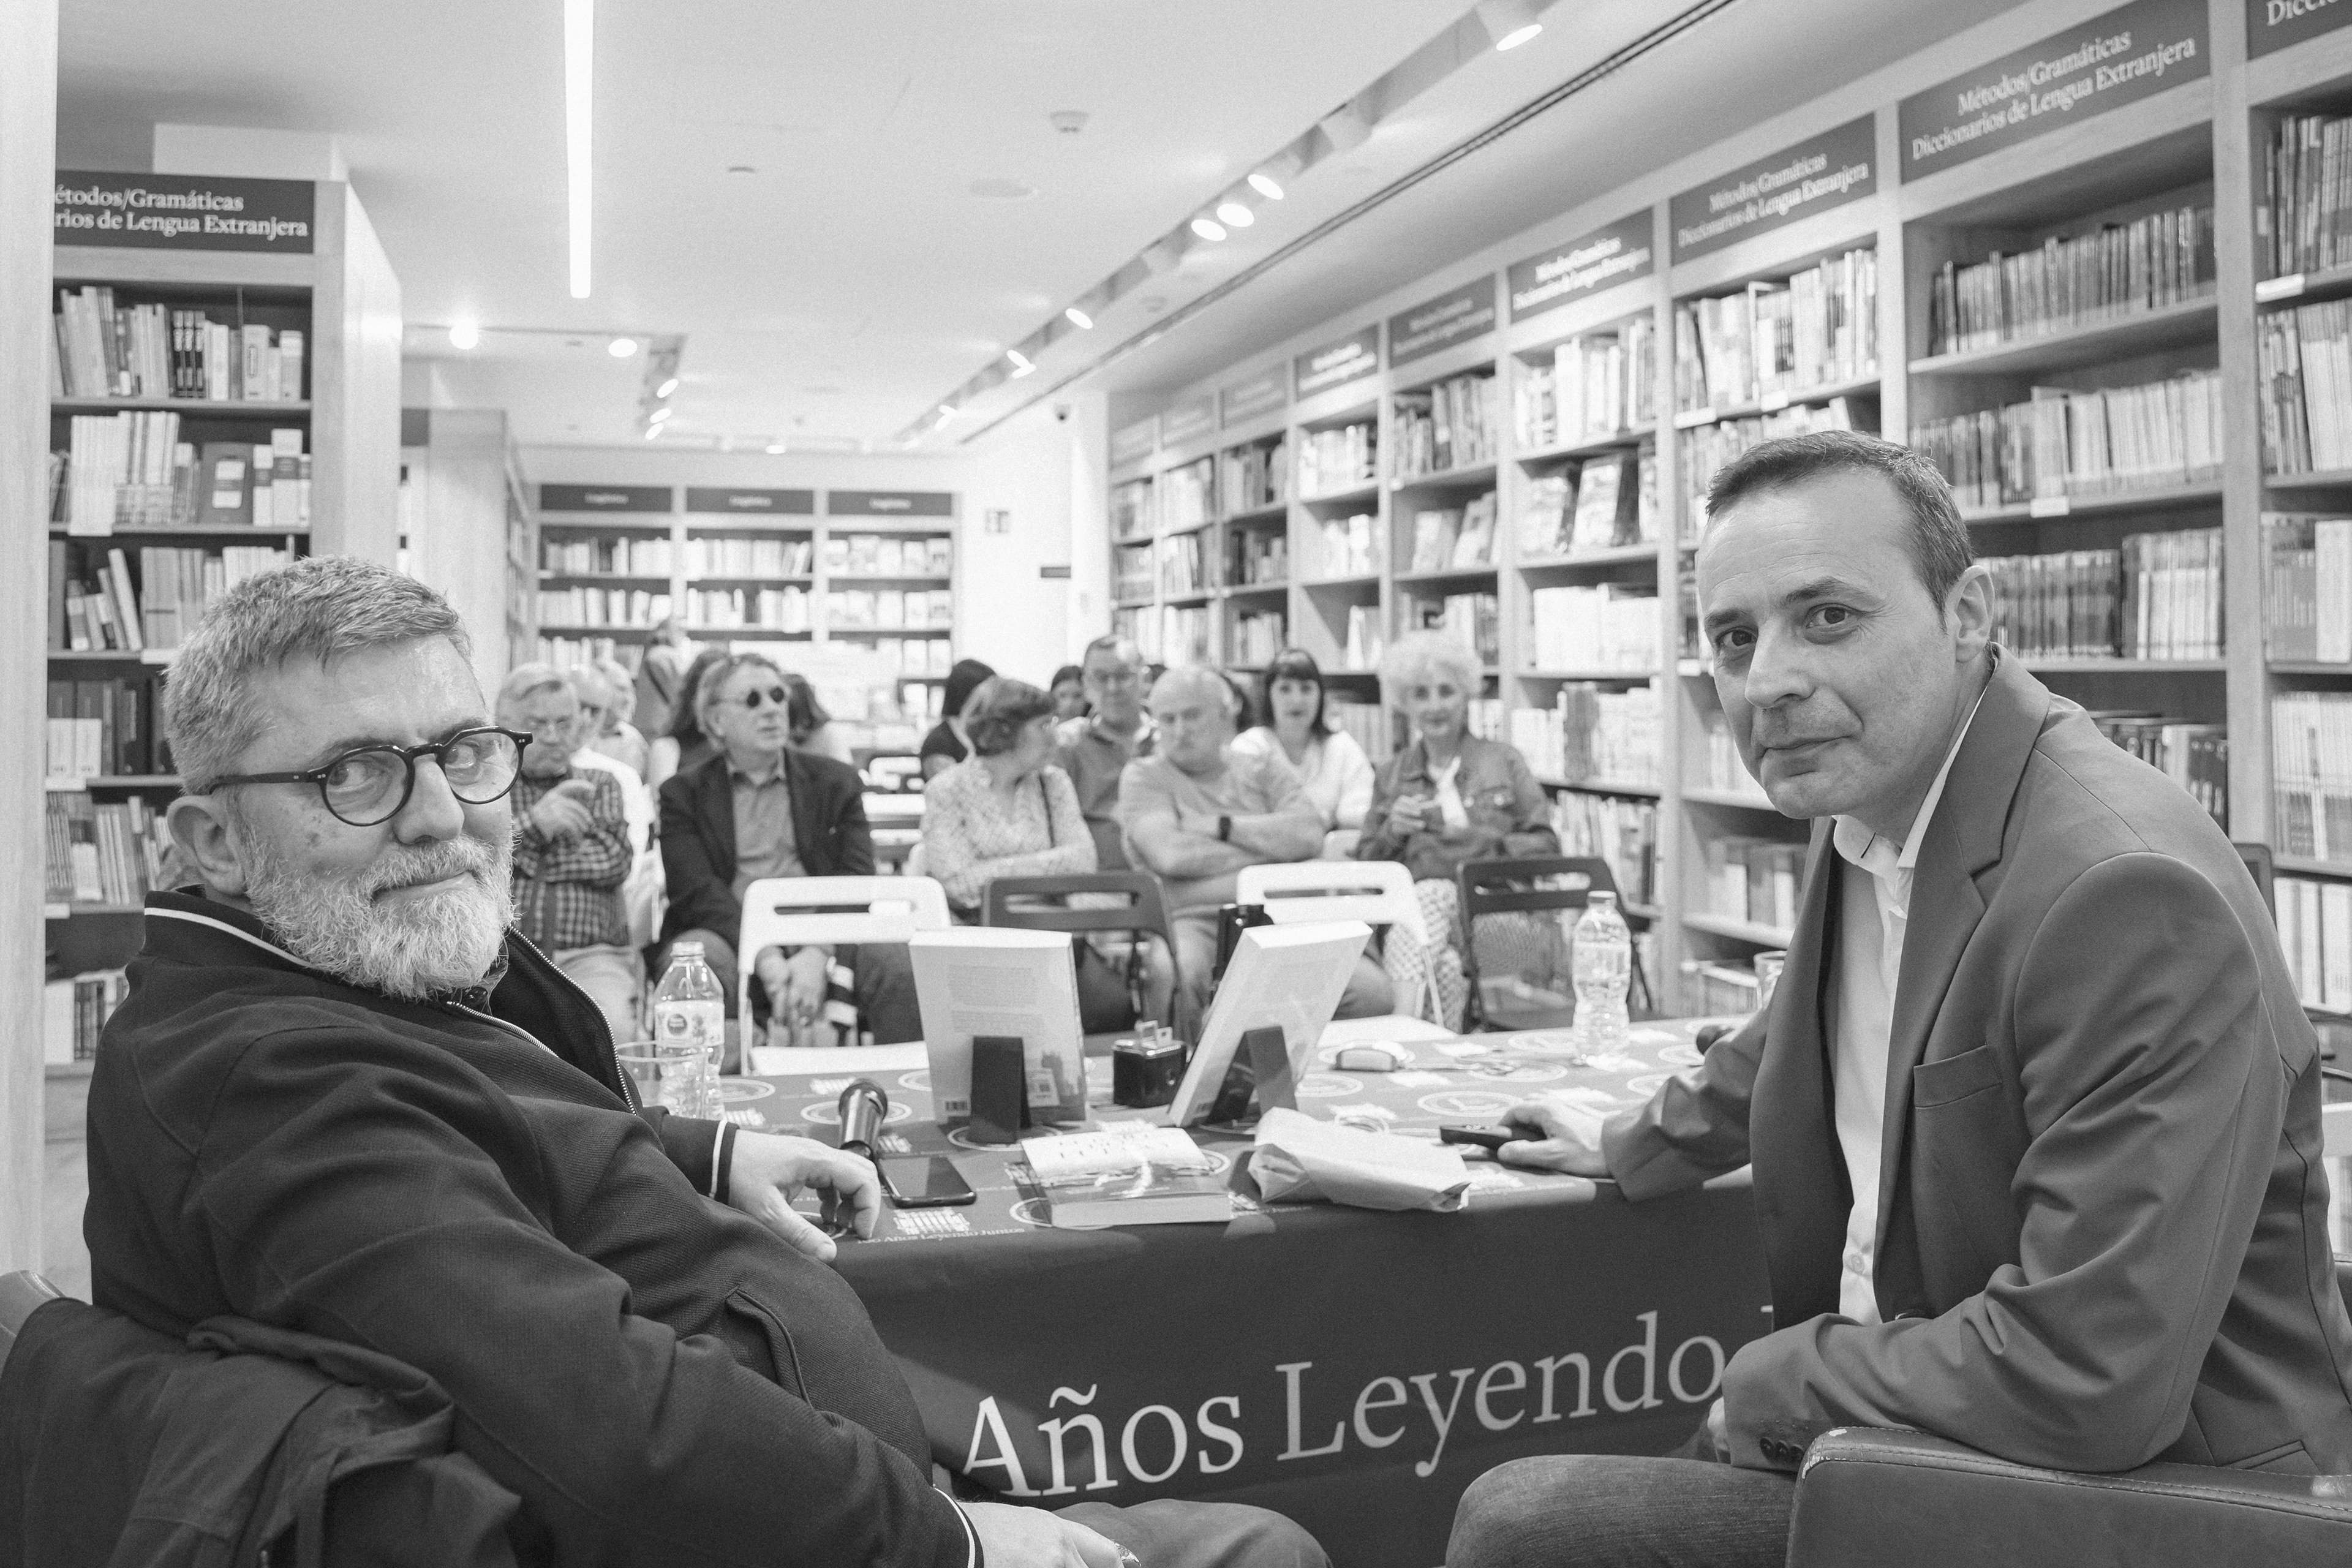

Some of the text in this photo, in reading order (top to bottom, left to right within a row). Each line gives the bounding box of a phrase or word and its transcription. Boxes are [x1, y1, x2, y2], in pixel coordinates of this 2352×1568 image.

[1912, 37, 2197, 160] Diccionarios de Lengua Extranjera
[1958, 31, 2132, 116] Métodos/Gramáticas
[97, 209, 123, 229] de
[126, 211, 200, 237] Lengua
[204, 214, 307, 241] Extranjera
[963, 1310, 1726, 1496] Años Leyendo
